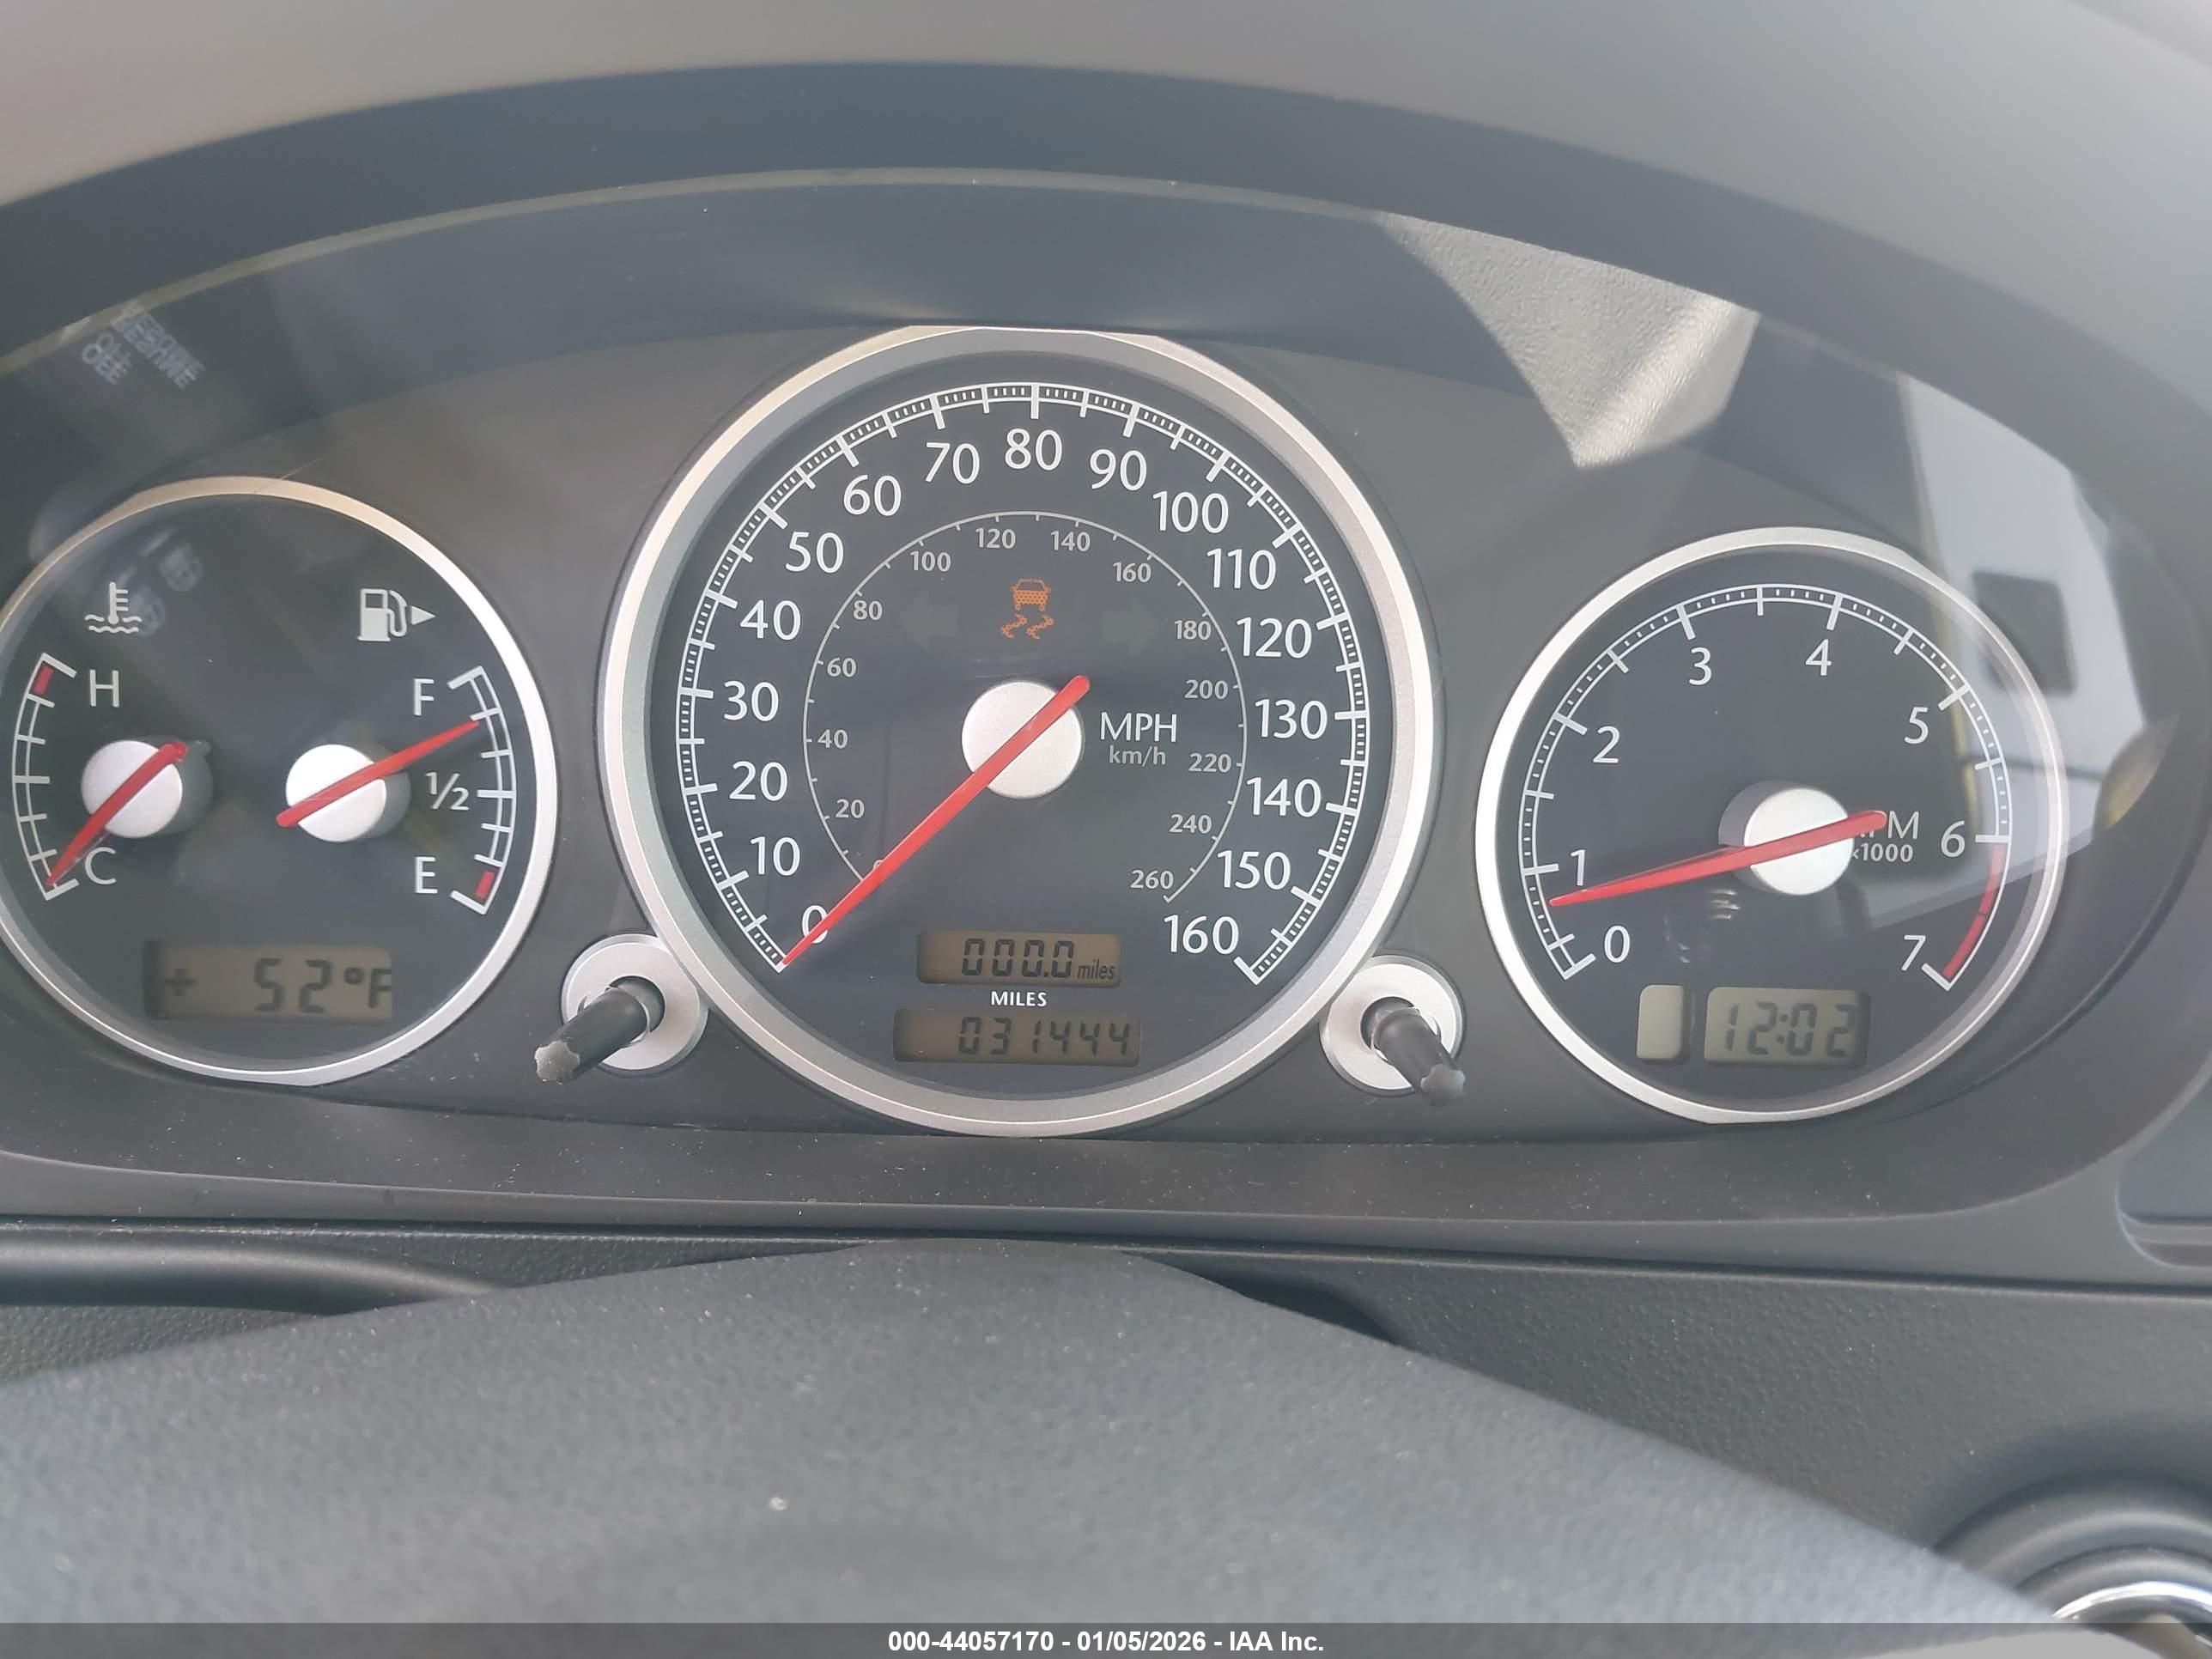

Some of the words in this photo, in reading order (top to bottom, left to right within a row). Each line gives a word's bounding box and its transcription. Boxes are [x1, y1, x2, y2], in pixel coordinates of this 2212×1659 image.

[925, 442, 980, 484] 70
[1005, 428, 1062, 471] 80
[1090, 448, 1147, 491] 90
[843, 474, 902, 516] 60
[1152, 490, 1229, 533] 100
[785, 531, 844, 574] 50
[975, 527, 1016, 550] 120
[1050, 530, 1091, 552] 140
[910, 550, 951, 572] 100
[1113, 562, 1152, 583] 160
[1206, 547, 1277, 590] 110
[739, 599, 801, 641] 40
[853, 600, 883, 620] 80
[1174, 619, 1212, 641] 180
[1237, 617, 1313, 659] 120
[827, 657, 857, 678] 60
[1688, 647, 1712, 685] 3
[1805, 639, 1832, 676] 4
[89, 669, 119, 708] H
[414, 678, 434, 716] F
[724, 680, 779, 722] 30
[1184, 679, 1229, 700] 200
[1100, 712, 1177, 743] MPH
[1255, 699, 1328, 739] 130
[1904, 707, 1929, 744] 5
[817, 729, 848, 749] 40
[1109, 744, 1166, 767] km/h
[1593, 726, 1620, 763] 2
[729, 761, 788, 801] 20
[1188, 752, 1231, 773] 220
[835, 799, 865, 818] 20
[1246, 776, 1322, 817] 140
[1169, 812, 1212, 834] 240
[1941, 820, 1966, 858] 6
[84, 847, 117, 885] C
[416, 856, 438, 894] E
[750, 836, 801, 877] 10
[1217, 850, 1291, 890] 150
[1571, 849, 1586, 886] 1
[1130, 869, 1174, 890] 260
[802, 905, 829, 944] 0
[1164, 915, 1240, 955] 160
[961, 938, 1074, 979] 000.0
[1076, 958, 1115, 981] miles
[1604, 925, 1631, 963] 0
[1902, 934, 1927, 972] 7
[991, 991, 1047, 1007] MILES
[958, 1016, 1131, 1057] 031444
[1725, 1000, 1858, 1058] 12:02
